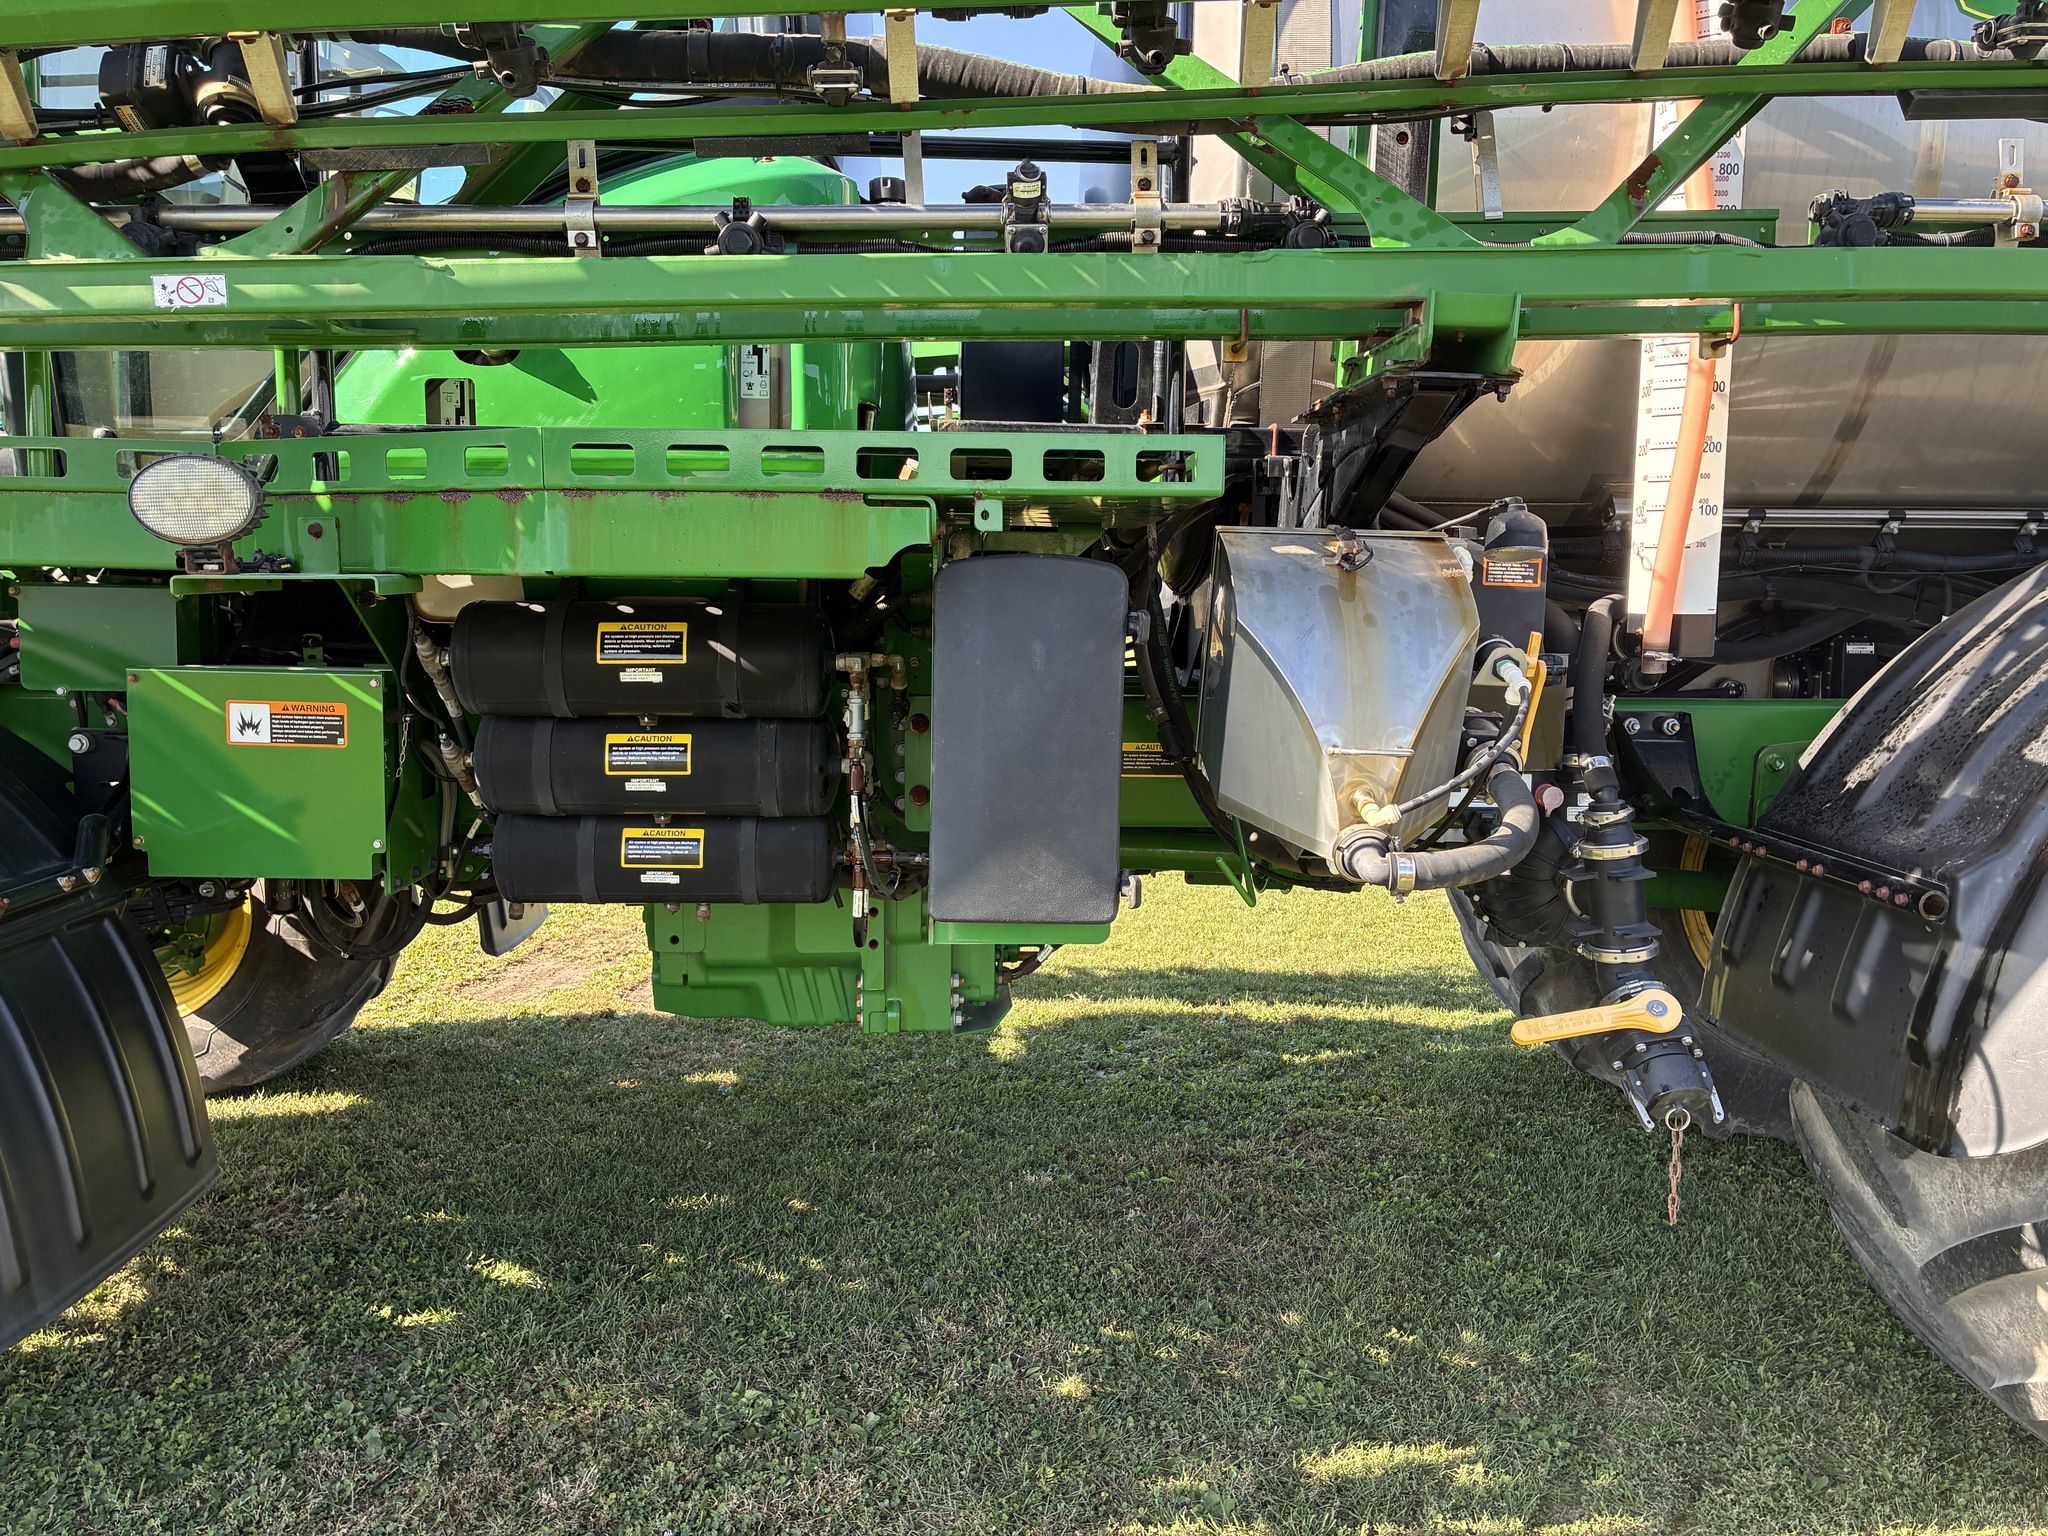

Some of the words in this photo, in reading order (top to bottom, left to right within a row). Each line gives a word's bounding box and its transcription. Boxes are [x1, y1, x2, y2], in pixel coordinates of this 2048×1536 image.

[1719, 163, 1739, 176] 800
[1713, 381, 1725, 392] 00
[1703, 442, 1721, 453] 200
[1699, 505, 1718, 516] 100
[1163, 657, 1178, 699] ALFAGOMMA
[291, 704, 335, 713] WARNING
